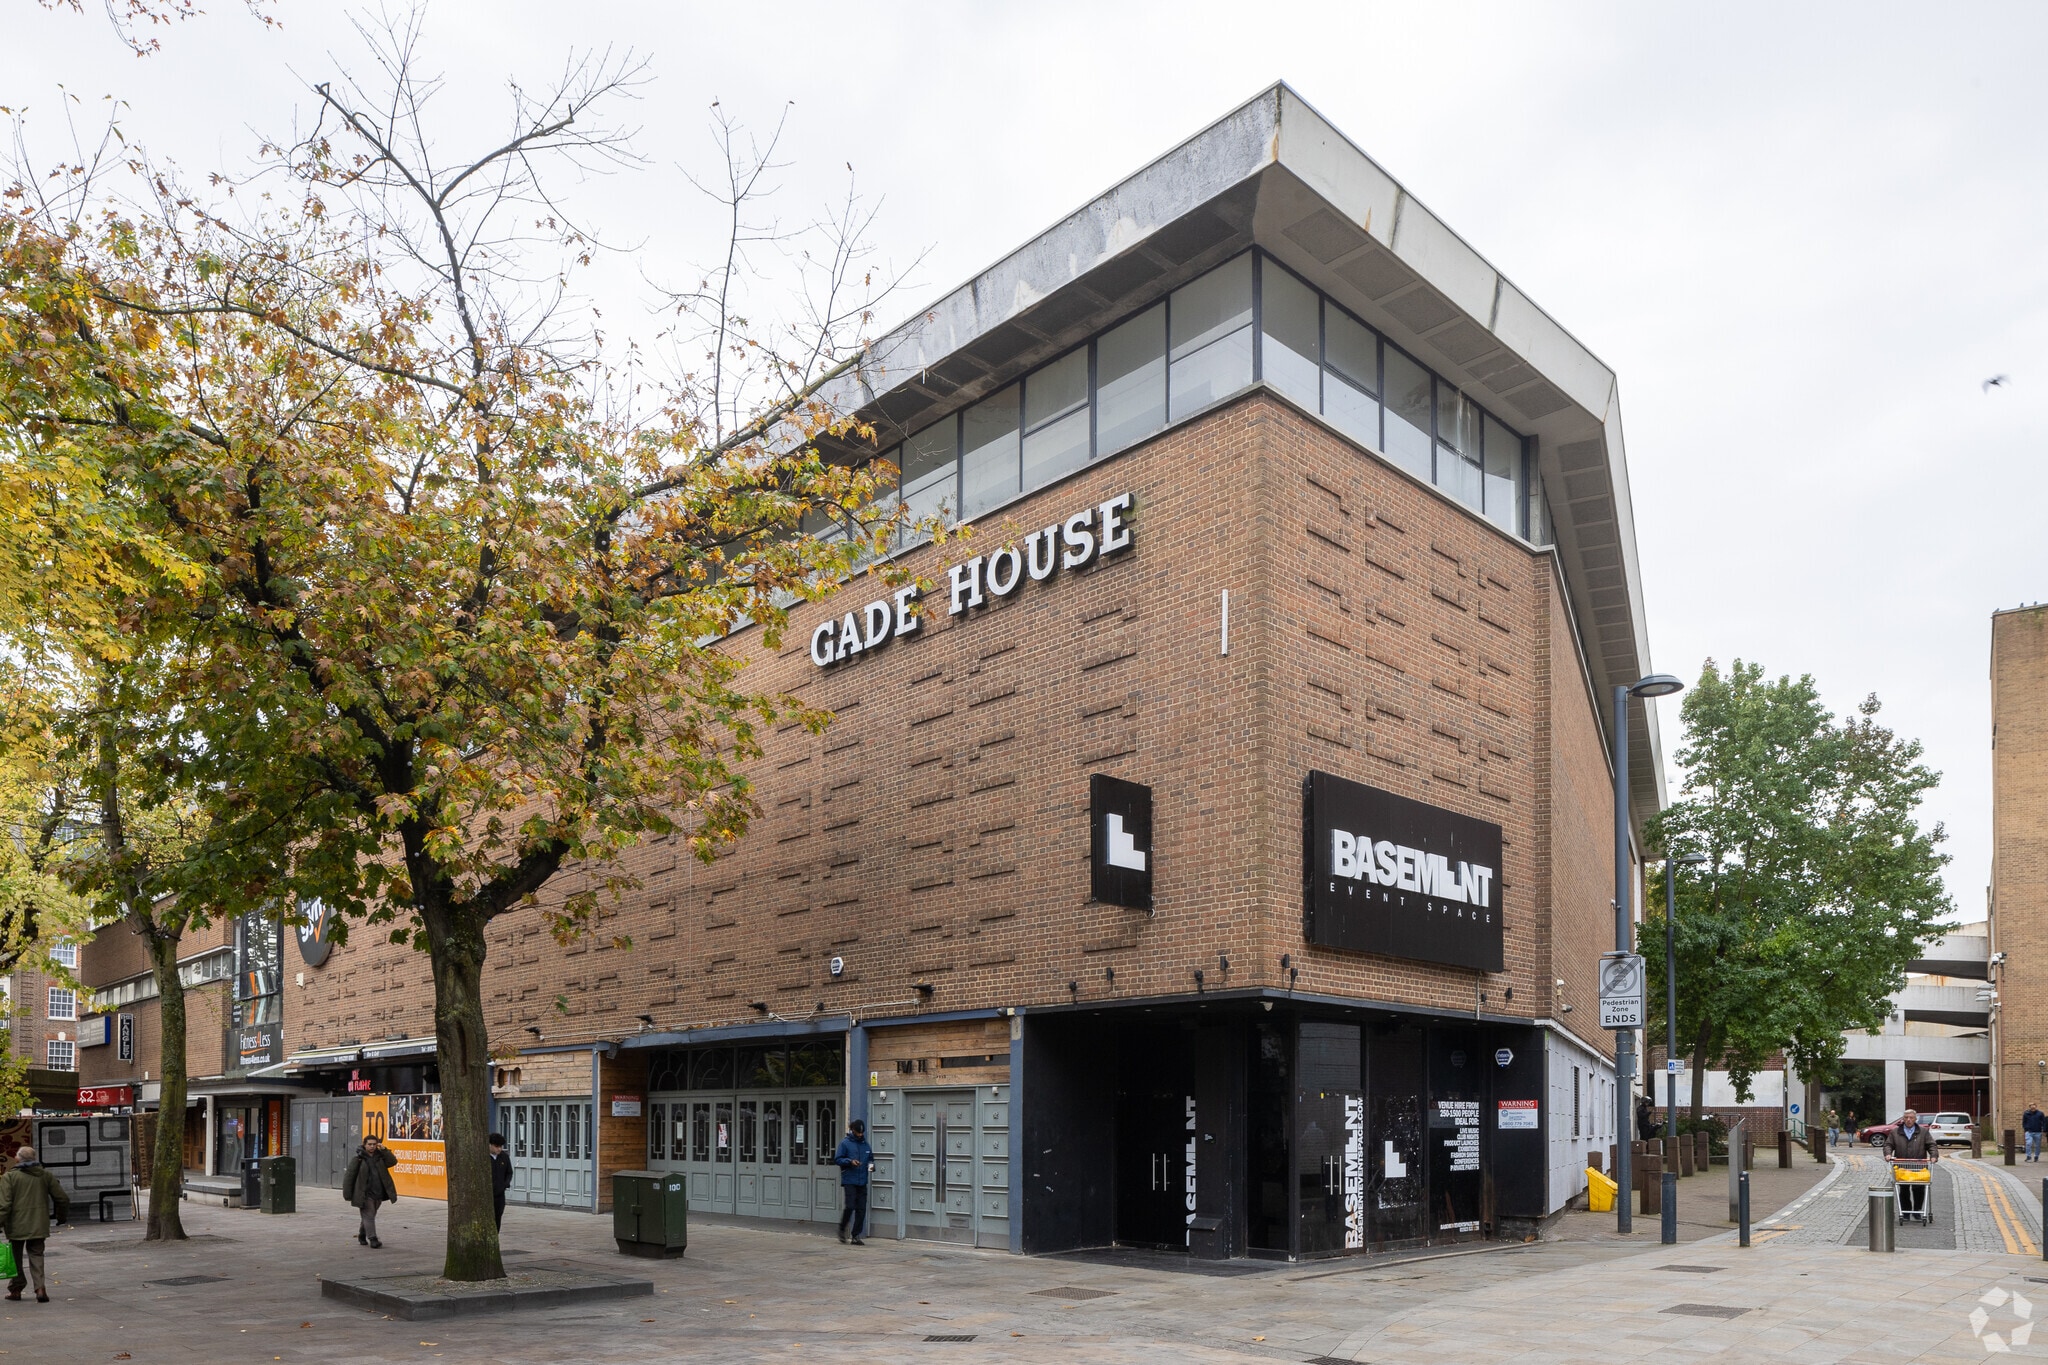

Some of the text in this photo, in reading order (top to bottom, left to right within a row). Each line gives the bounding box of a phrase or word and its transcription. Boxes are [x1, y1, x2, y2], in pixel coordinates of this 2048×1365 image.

[811, 493, 1134, 667] GADE HOUSE
[1330, 882, 1491, 923] EVENT SPACE
[1605, 1014, 1636, 1023] ENDS
[122, 1019, 130, 1058] LANGLEY
[1438, 1101, 1454, 1109] VENUE
[1454, 1101, 1466, 1109] HIRE
[366, 1111, 384, 1143] TO
[394, 1150, 444, 1162] GROUND FLOOR FITTED
[394, 1163, 444, 1176] LEISURE OPPORTUNITY
